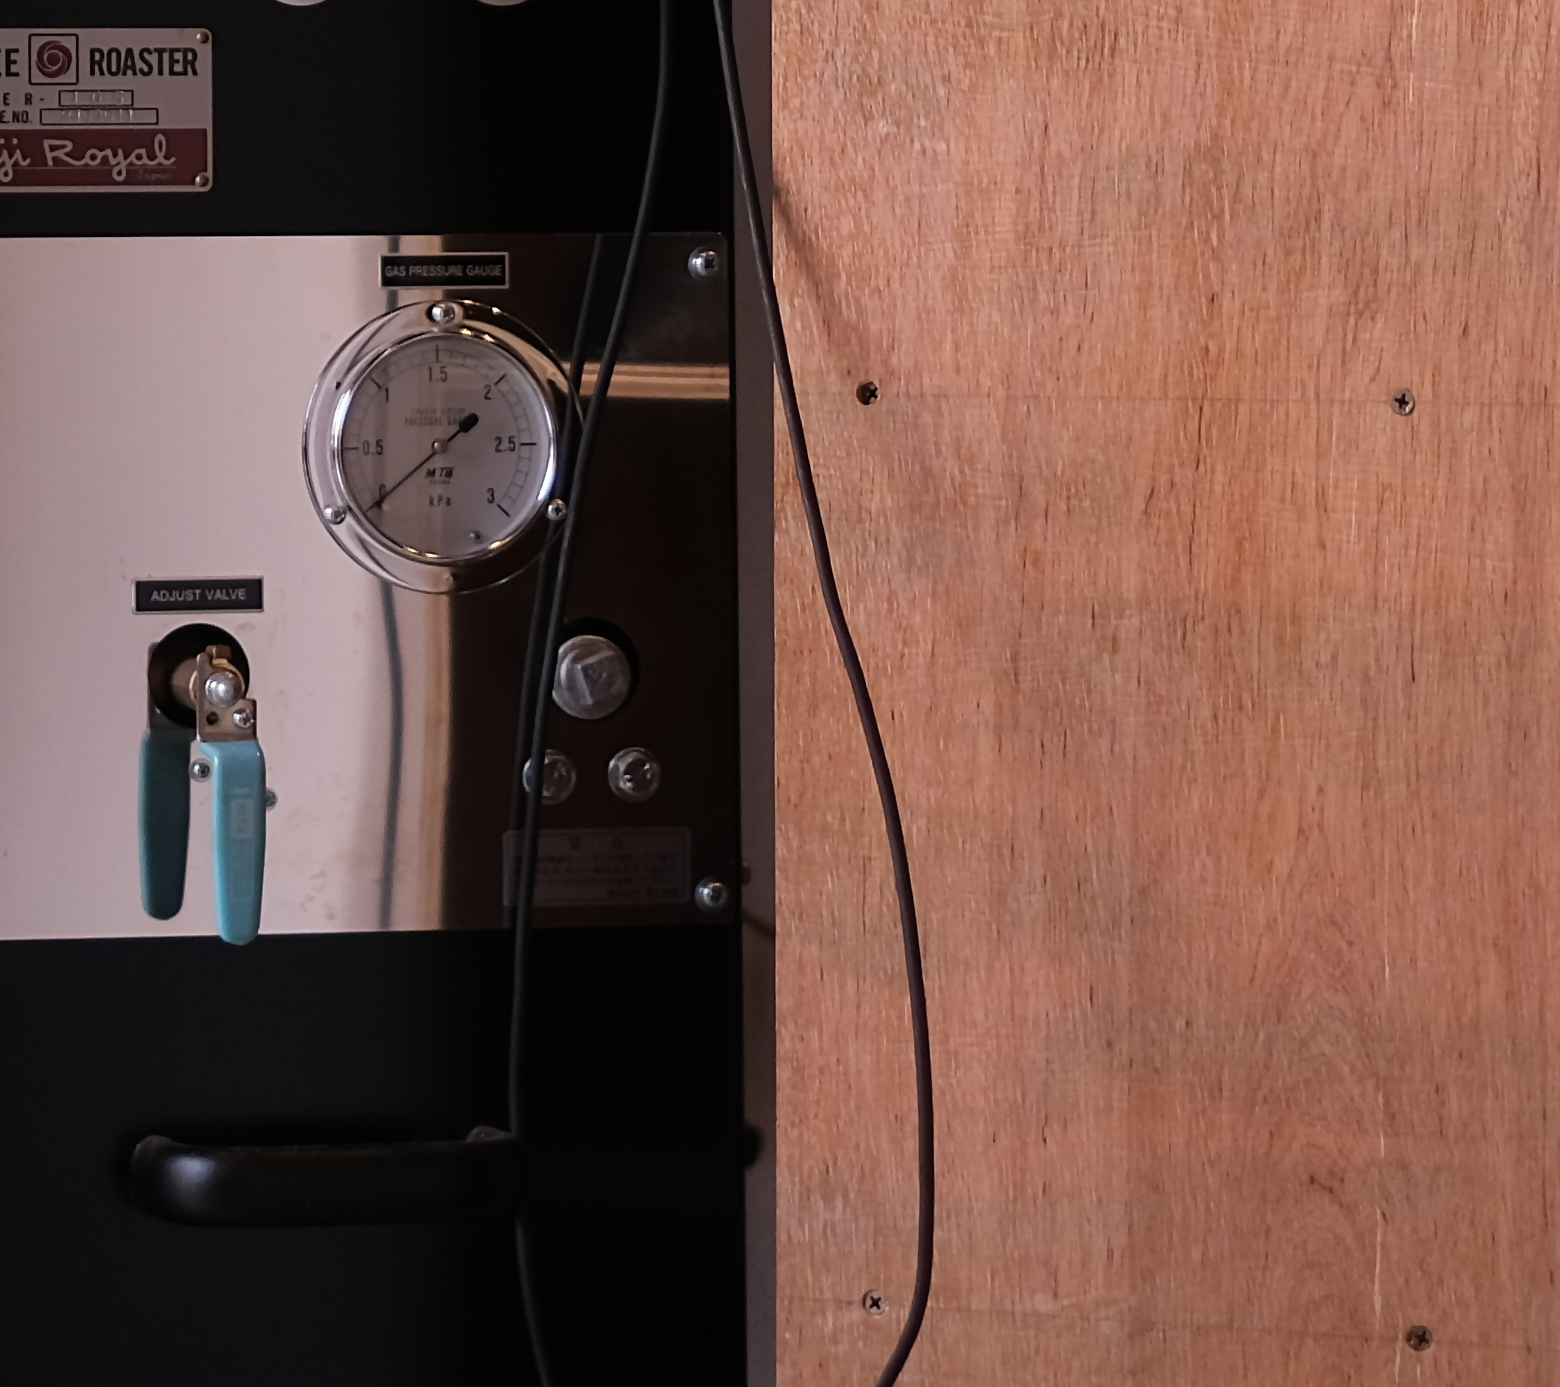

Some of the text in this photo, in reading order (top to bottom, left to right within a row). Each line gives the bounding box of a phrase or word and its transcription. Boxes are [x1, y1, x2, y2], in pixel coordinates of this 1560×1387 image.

[88, 47, 199, 78] ROASTER
[43, 133, 177, 183] Royal
[384, 264, 503, 278] GAS PRESSURE GAUGE
[427, 365, 449, 383] 1.5
[384, 386, 390, 404] 1
[483, 384, 492, 401] 2
[362, 438, 385, 456] 0.5
[494, 435, 517, 454] 2.5
[428, 494, 452, 507] kPa
[486, 487, 496, 505] 3
[150, 588, 248, 602] ADJUST VALVE
